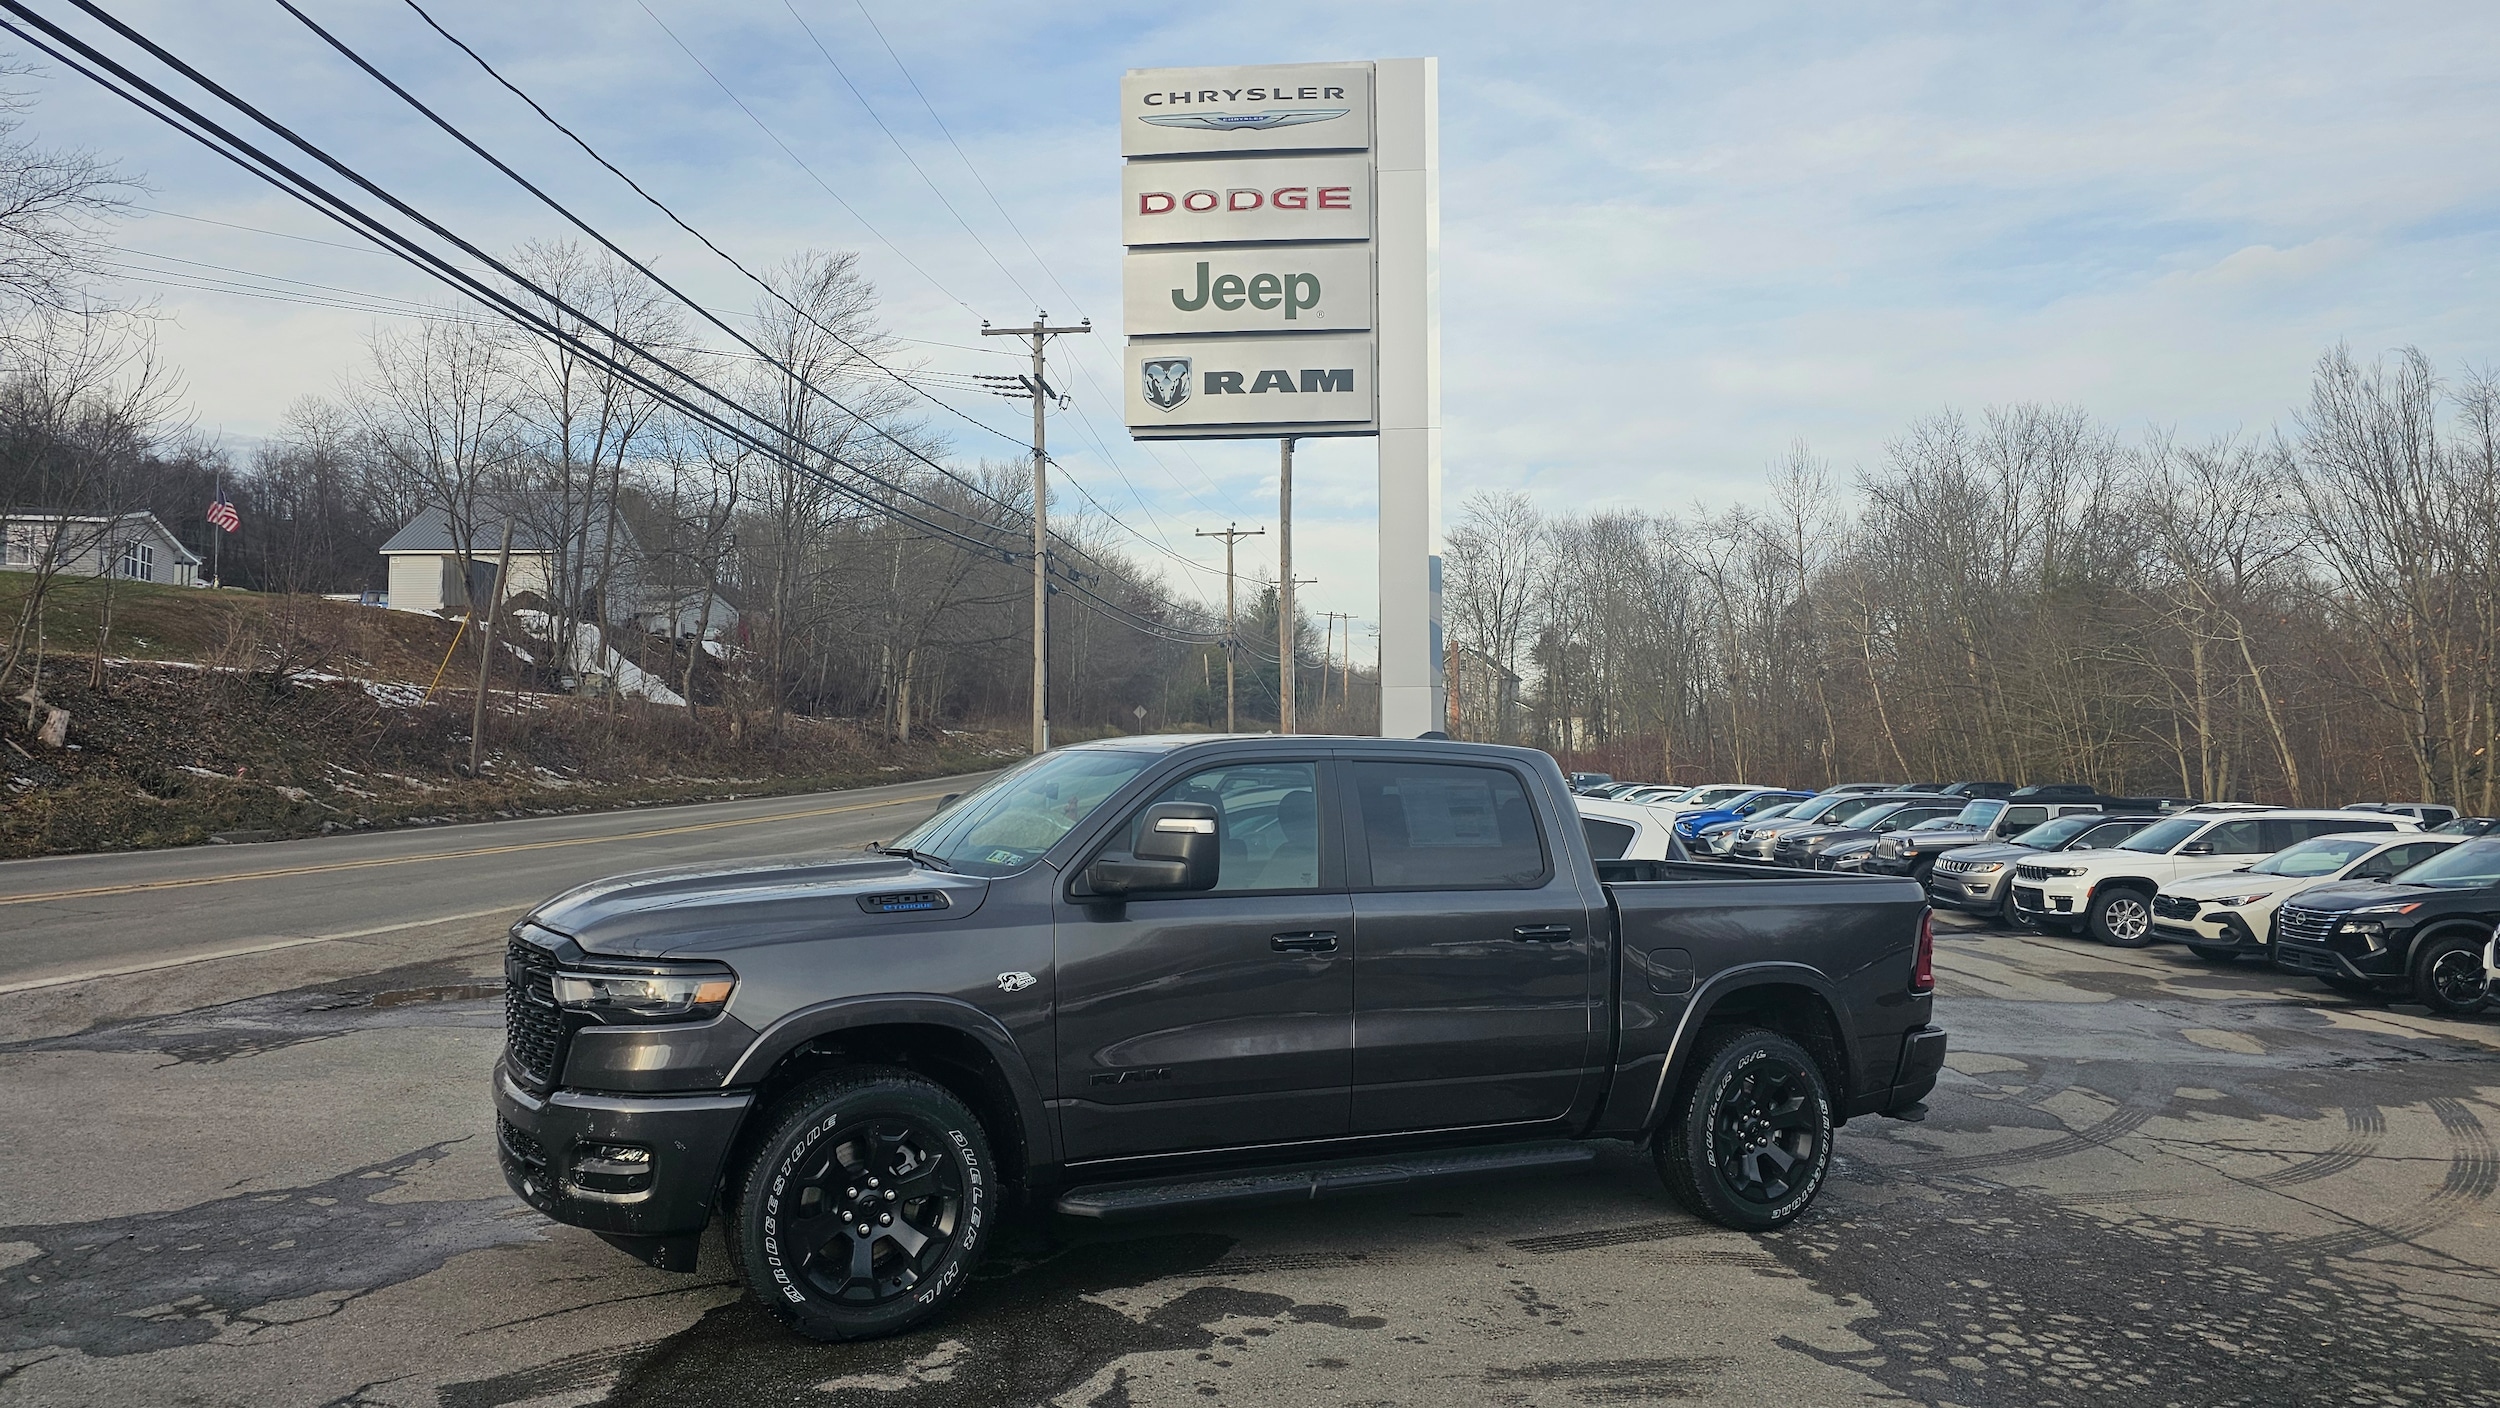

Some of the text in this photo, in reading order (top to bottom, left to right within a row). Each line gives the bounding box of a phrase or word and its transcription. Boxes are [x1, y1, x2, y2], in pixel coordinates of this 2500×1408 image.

[1143, 87, 1345, 106] CHRYSLER
[1139, 186, 1352, 216] DODGE
[1171, 261, 1321, 320] Jeep
[1204, 369, 1354, 395] RAM
[868, 893, 936, 905] 1500
[1706, 1071, 1732, 1168] DUELER
[1771, 1098, 1831, 1220] BRIDGESTONE
[764, 1113, 838, 1304] BRIDGESTONE
[949, 1129, 983, 1250] DUELER
